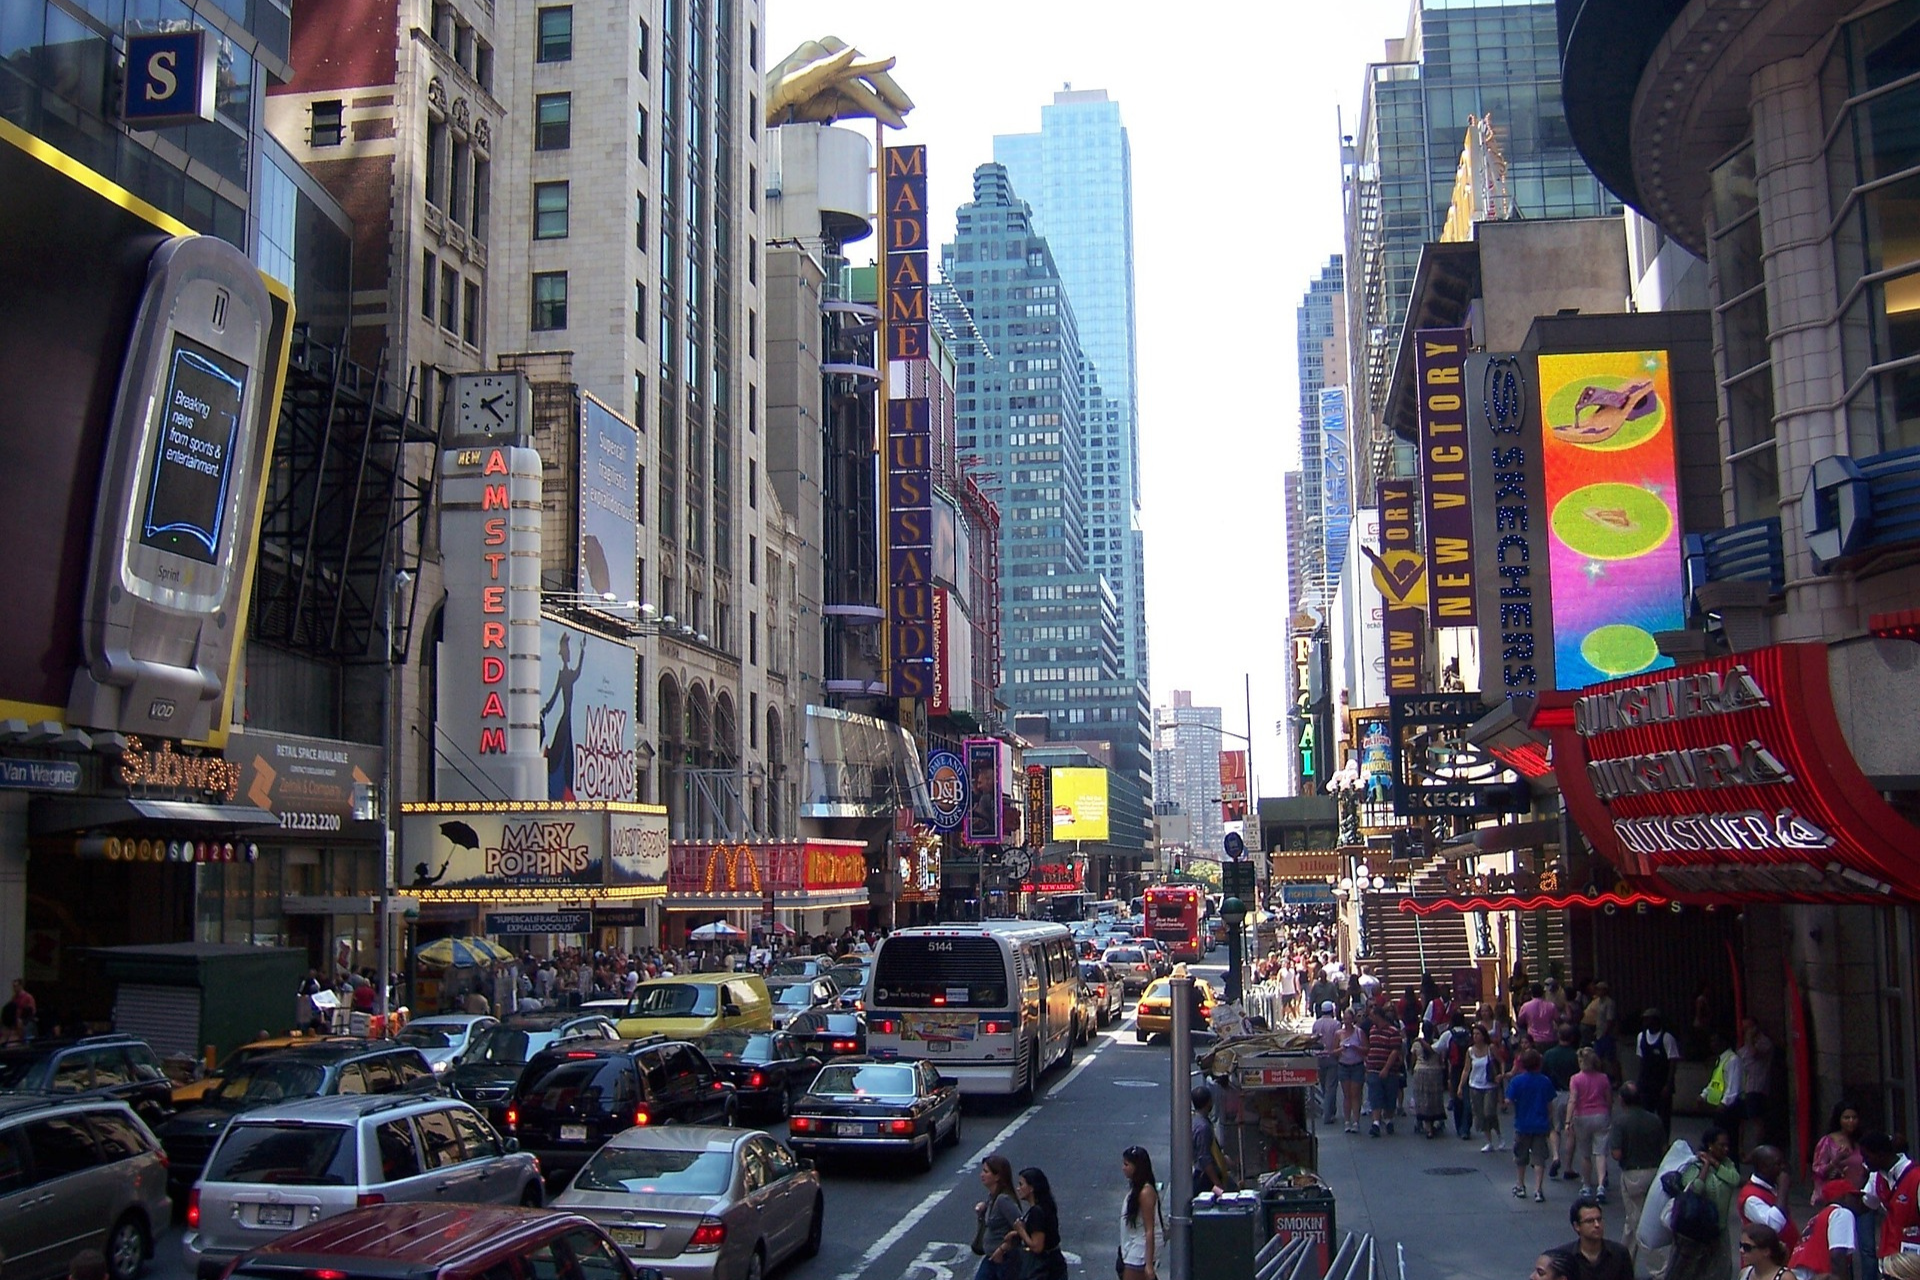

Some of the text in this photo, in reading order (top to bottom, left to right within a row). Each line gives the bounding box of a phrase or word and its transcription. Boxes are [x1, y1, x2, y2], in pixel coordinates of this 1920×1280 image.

[144, 50, 179, 101] S
[889, 146, 924, 357] MADAME
[484, 378, 493, 387] 12
[171, 410, 194, 430] news
[174, 389, 211, 420] Breaking
[1321, 389, 1345, 431] NEW
[1425, 341, 1465, 510] VICTORY
[168, 428, 222, 459] from sports &
[457, 450, 482, 466] NEW
[895, 400, 925, 696] TUSSAUDS
[158, 565, 180, 583] Sprint
[1435, 537, 1472, 618] NEW
[1491, 446, 1536, 687] SKECHERS
[479, 449, 511, 755] AMSTERDAM
[1389, 630, 1416, 690] NEW
[932, 682, 943, 708] Club
[585, 704, 627, 752] MARY
[2, 763, 78, 787] Van Wagner
[575, 742, 635, 800] POPPINS
[928, 756, 963, 776] DAVE AND
[930, 778, 964, 802] D&B
[279, 811, 342, 832] 212.223.2200
[1031, 778, 1042, 846] EMPIRE
[501, 821, 576, 852] MARY
[1613, 815, 1779, 855] QUIKSILVER
[485, 845, 588, 877] POPPINS
[1587, 885, 1598, 897] A
[1604, 903, 1616, 916] C
[1636, 902, 1647, 914] E
[1670, 901, 1682, 913] S
[928, 941, 953, 951] 5144
[1276, 1216, 1326, 1230] SMOKIN'
